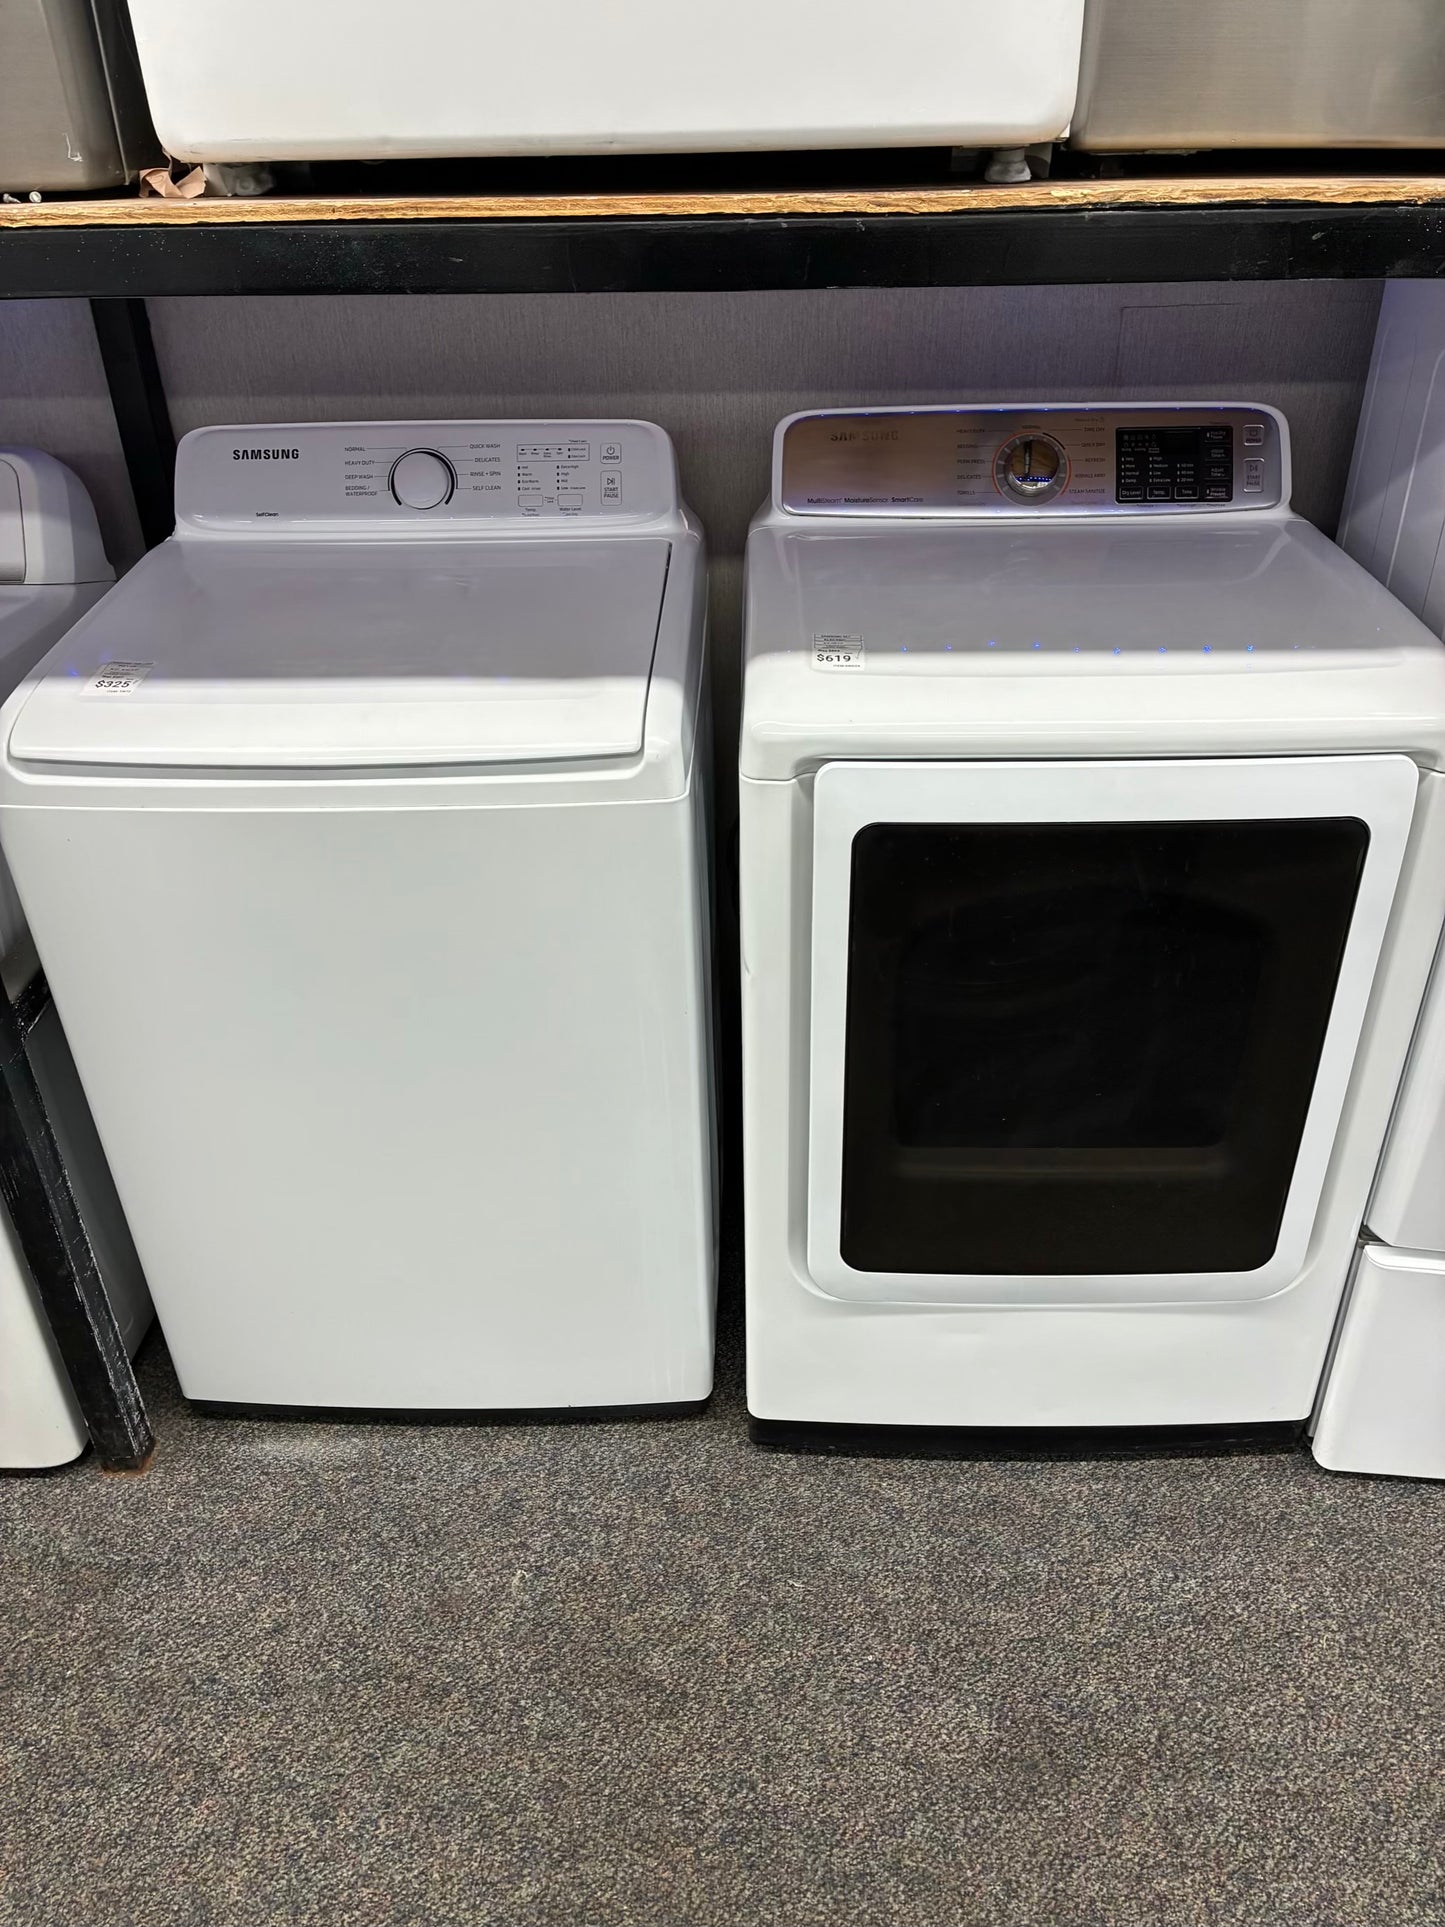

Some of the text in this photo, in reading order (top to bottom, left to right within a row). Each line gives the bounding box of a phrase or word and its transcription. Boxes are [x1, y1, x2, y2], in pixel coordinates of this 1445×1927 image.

[232, 448, 300, 460] SAMSUNG
[817, 654, 851, 662] $619
[94, 679, 132, 688] $325
